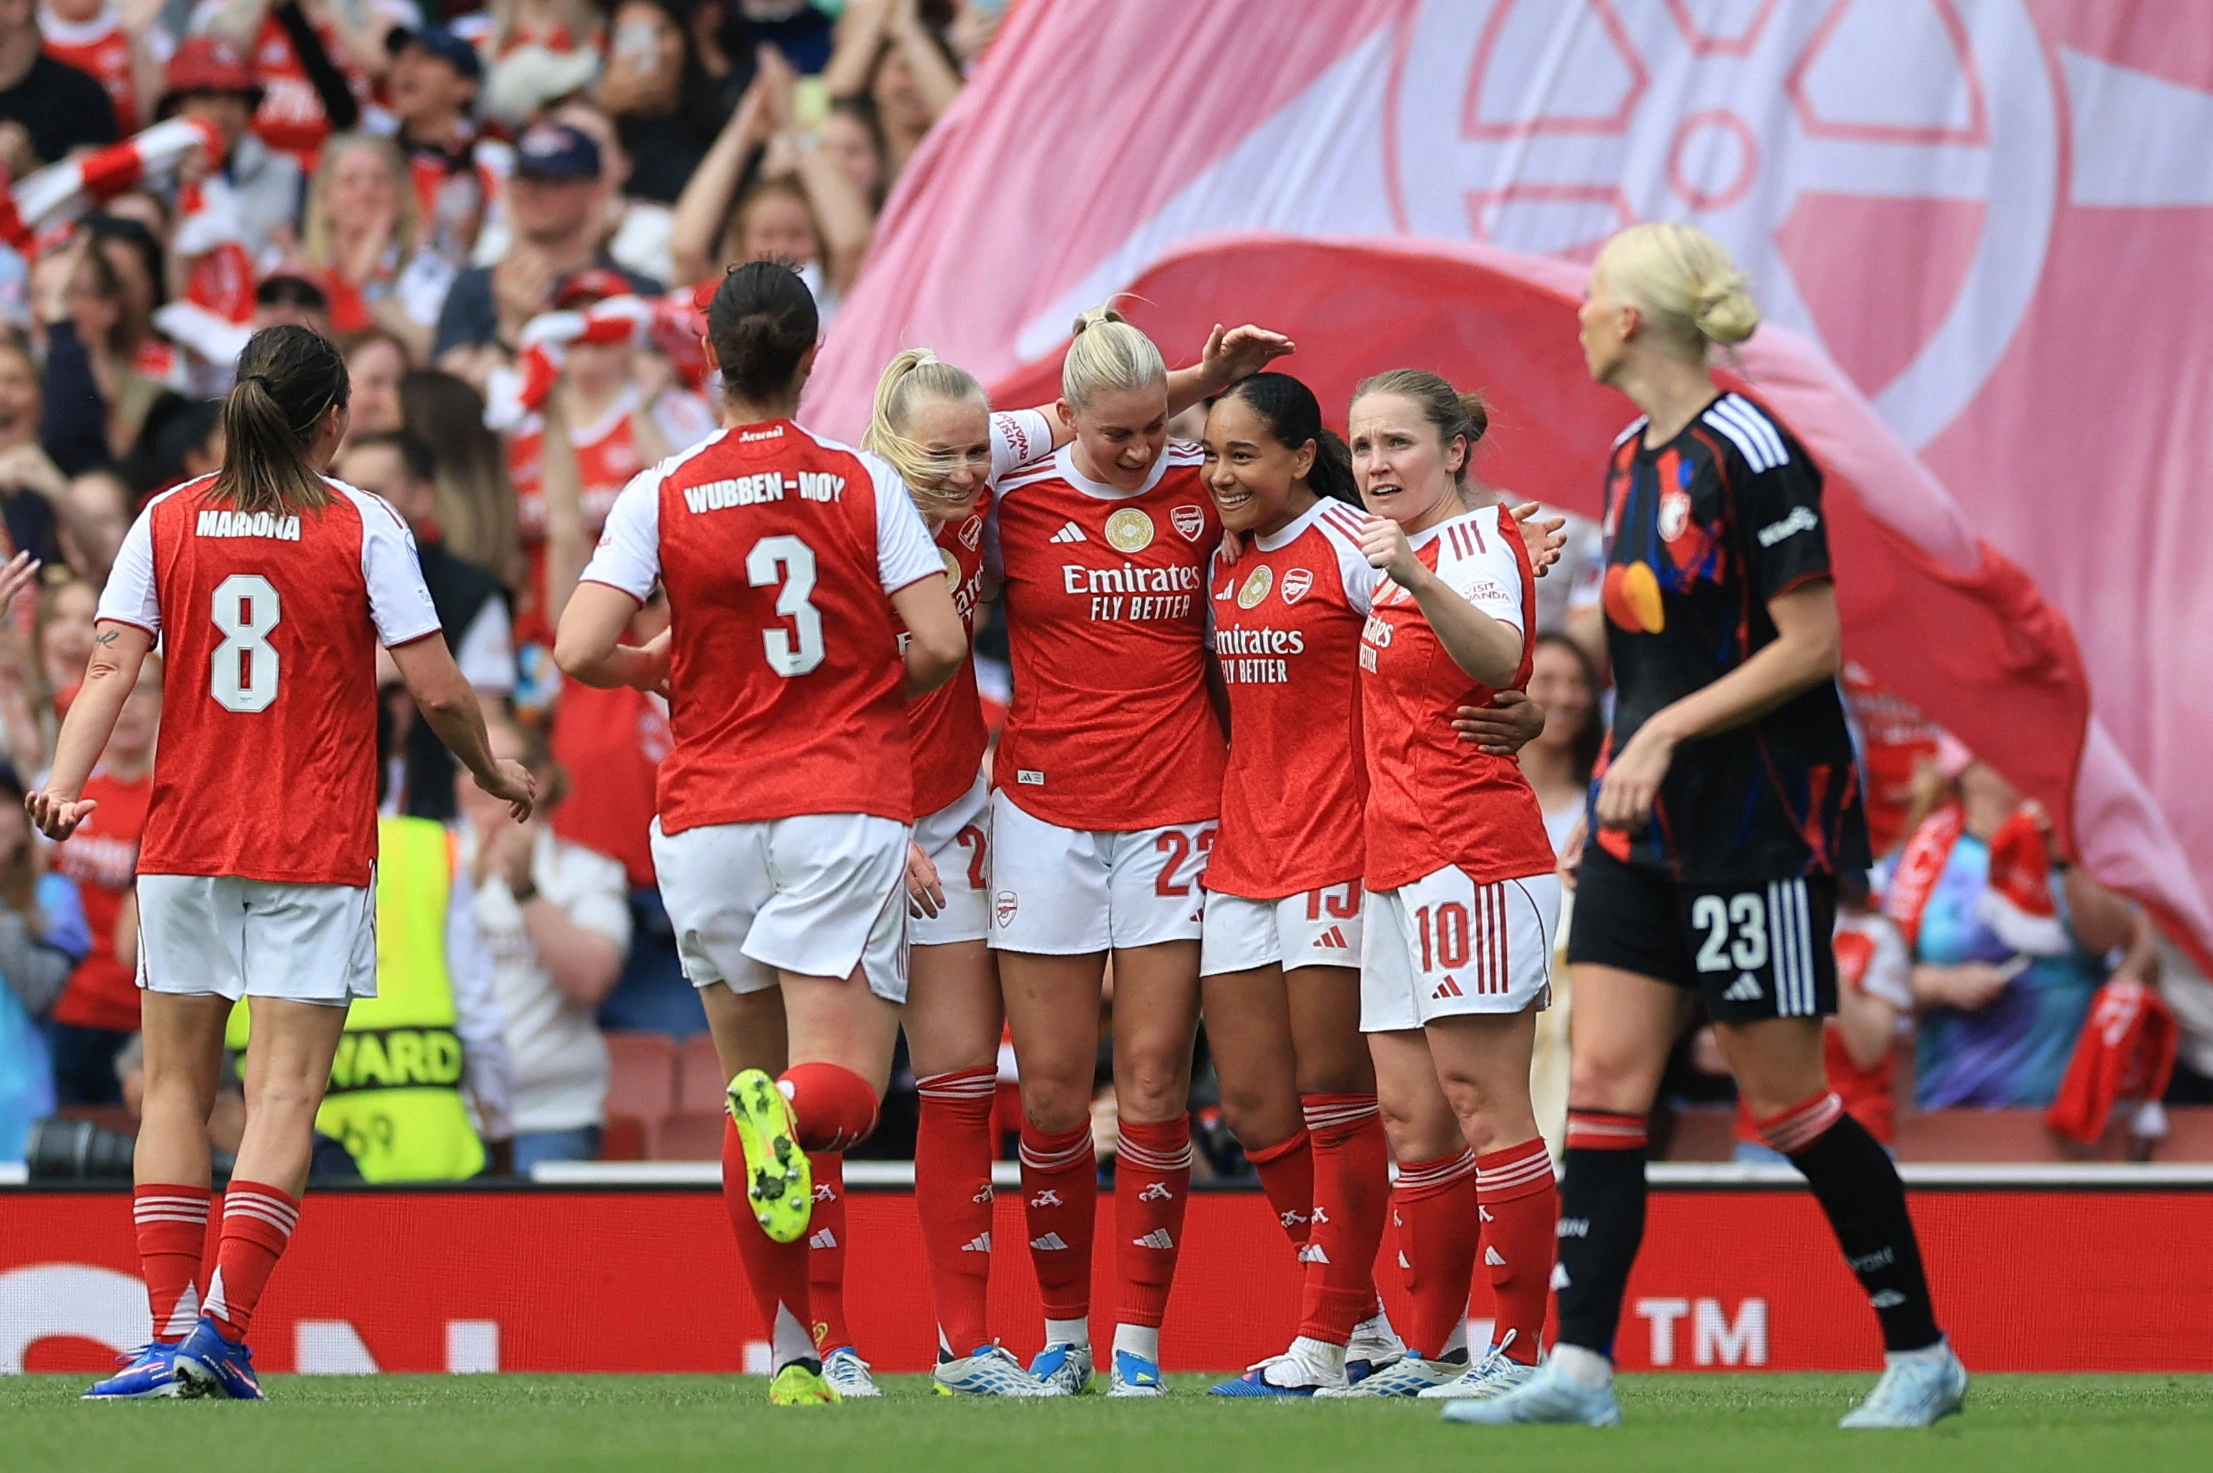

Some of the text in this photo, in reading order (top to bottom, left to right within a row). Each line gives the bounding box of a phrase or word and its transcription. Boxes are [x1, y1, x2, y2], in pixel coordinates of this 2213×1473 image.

[738, 425, 785, 443] Arsenal
[995, 420, 1017, 450] VISIT
[683, 471, 846, 514] WUBBEN-MOY
[195, 509, 301, 541] MARIONA
[1062, 562, 1200, 594] Emirates
[1464, 582, 1495, 595] VISIT
[745, 533, 826, 678] 3
[1091, 595, 1190, 621] FLY BETTER
[1465, 591, 1511, 602] ANDA
[211, 574, 281, 713] 8
[1214, 623, 1304, 655] mirates
[1239, 659, 1288, 683] BETTER
[1415, 901, 1471, 974] 10
[1692, 892, 1768, 972] 23
[1635, 1298, 1768, 1367] TM
